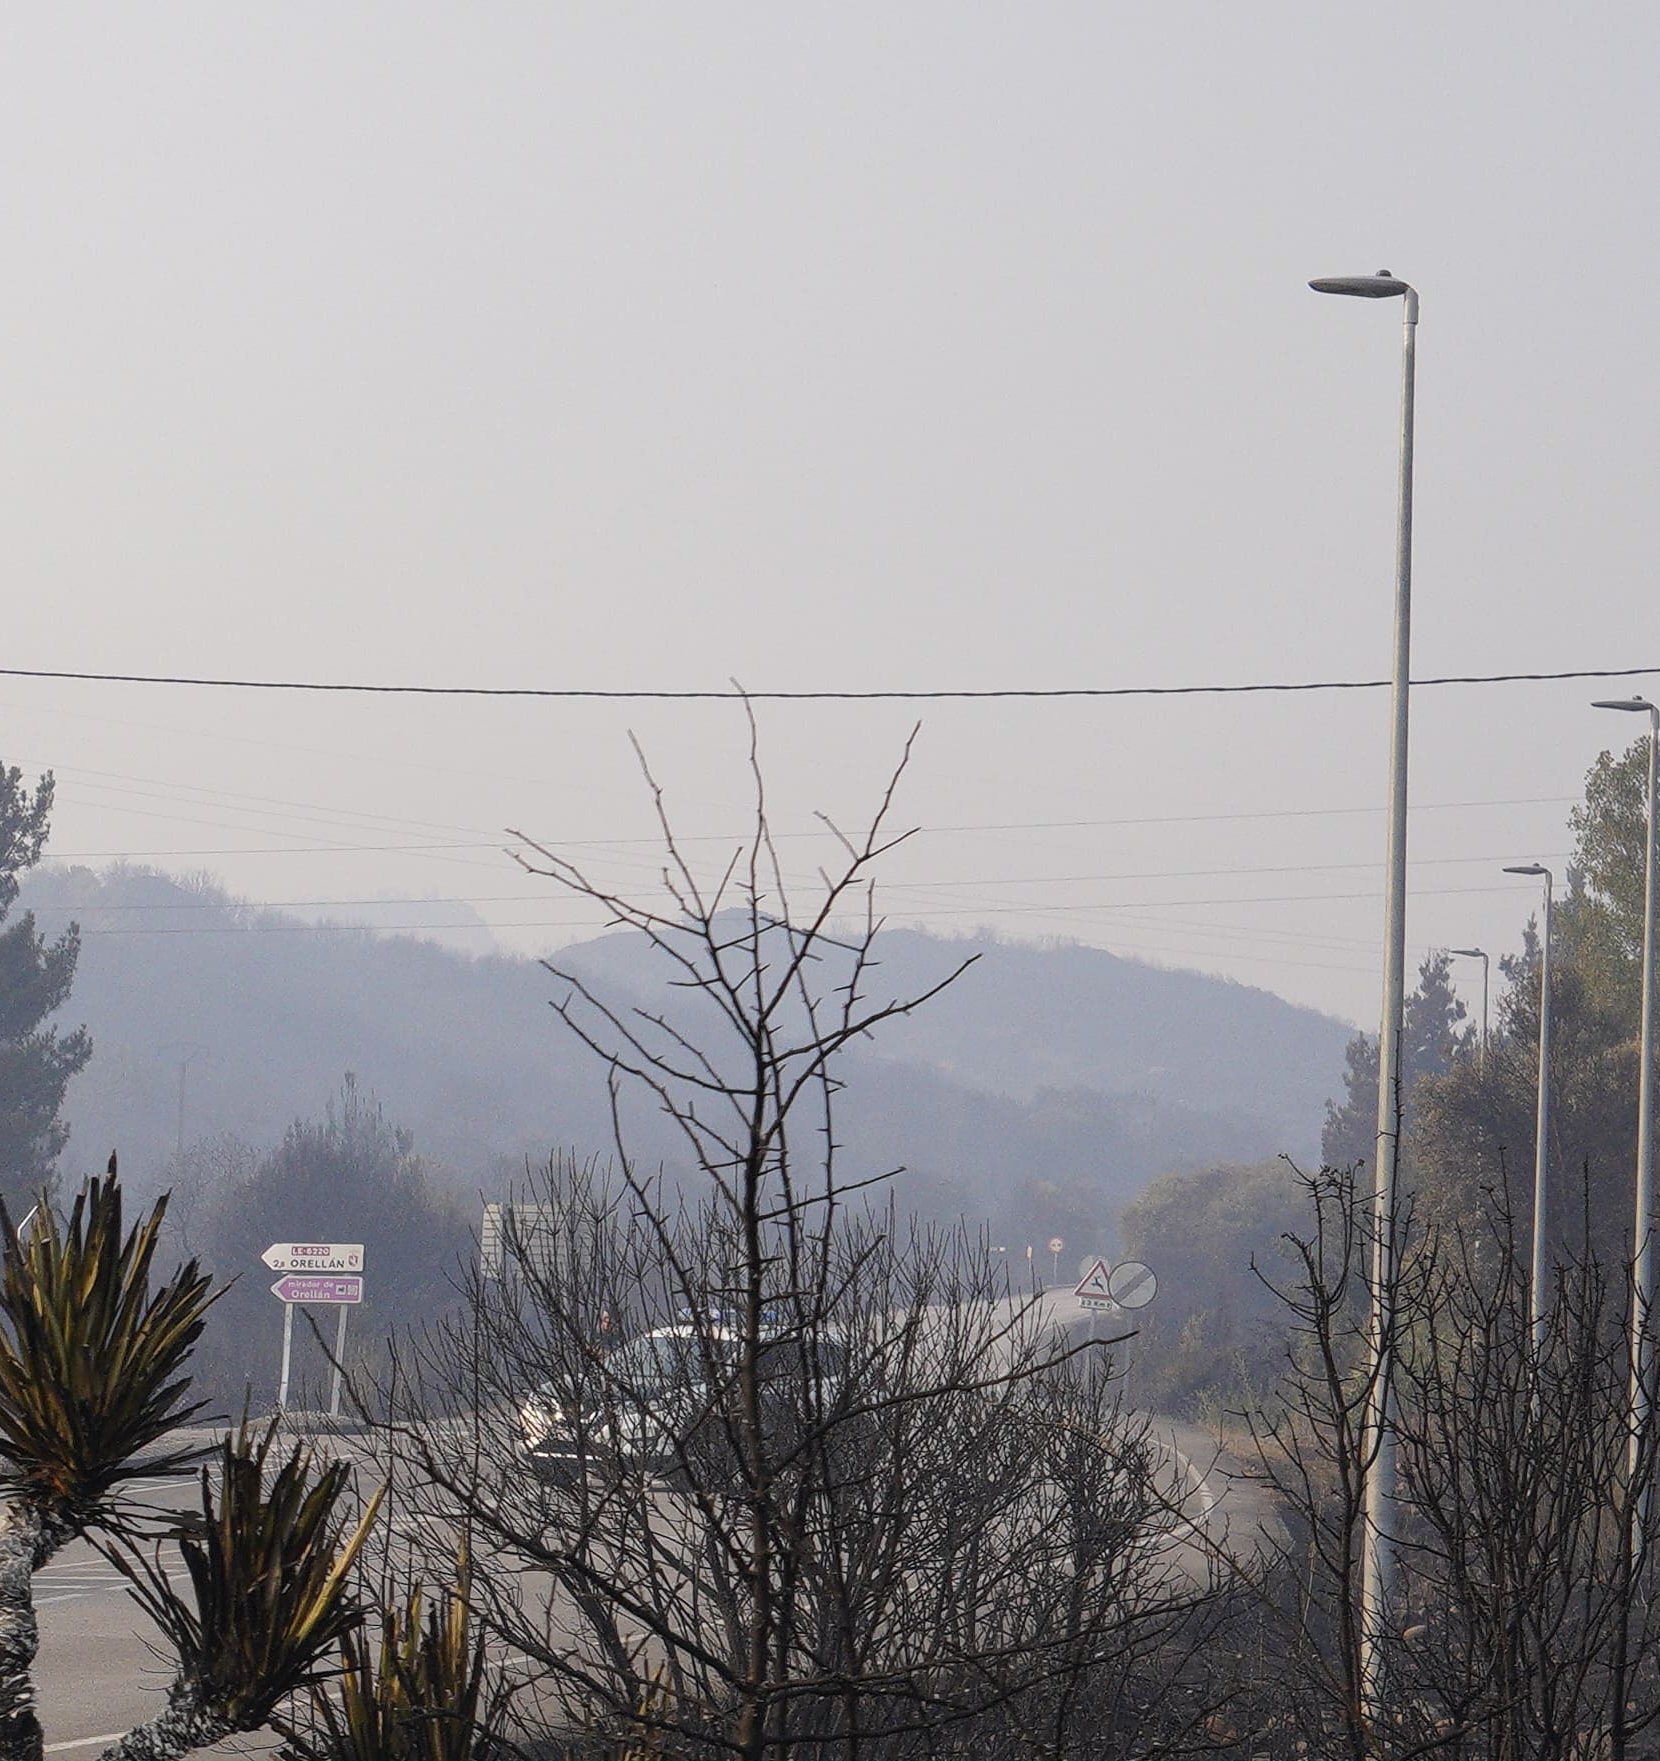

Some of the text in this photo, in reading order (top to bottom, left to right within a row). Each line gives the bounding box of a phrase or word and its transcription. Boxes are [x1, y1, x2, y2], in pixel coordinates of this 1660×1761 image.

[290, 1257, 345, 1269] ORELLÁN
[288, 1280, 321, 1288] mirador
[291, 1289, 330, 1299] Orellán
